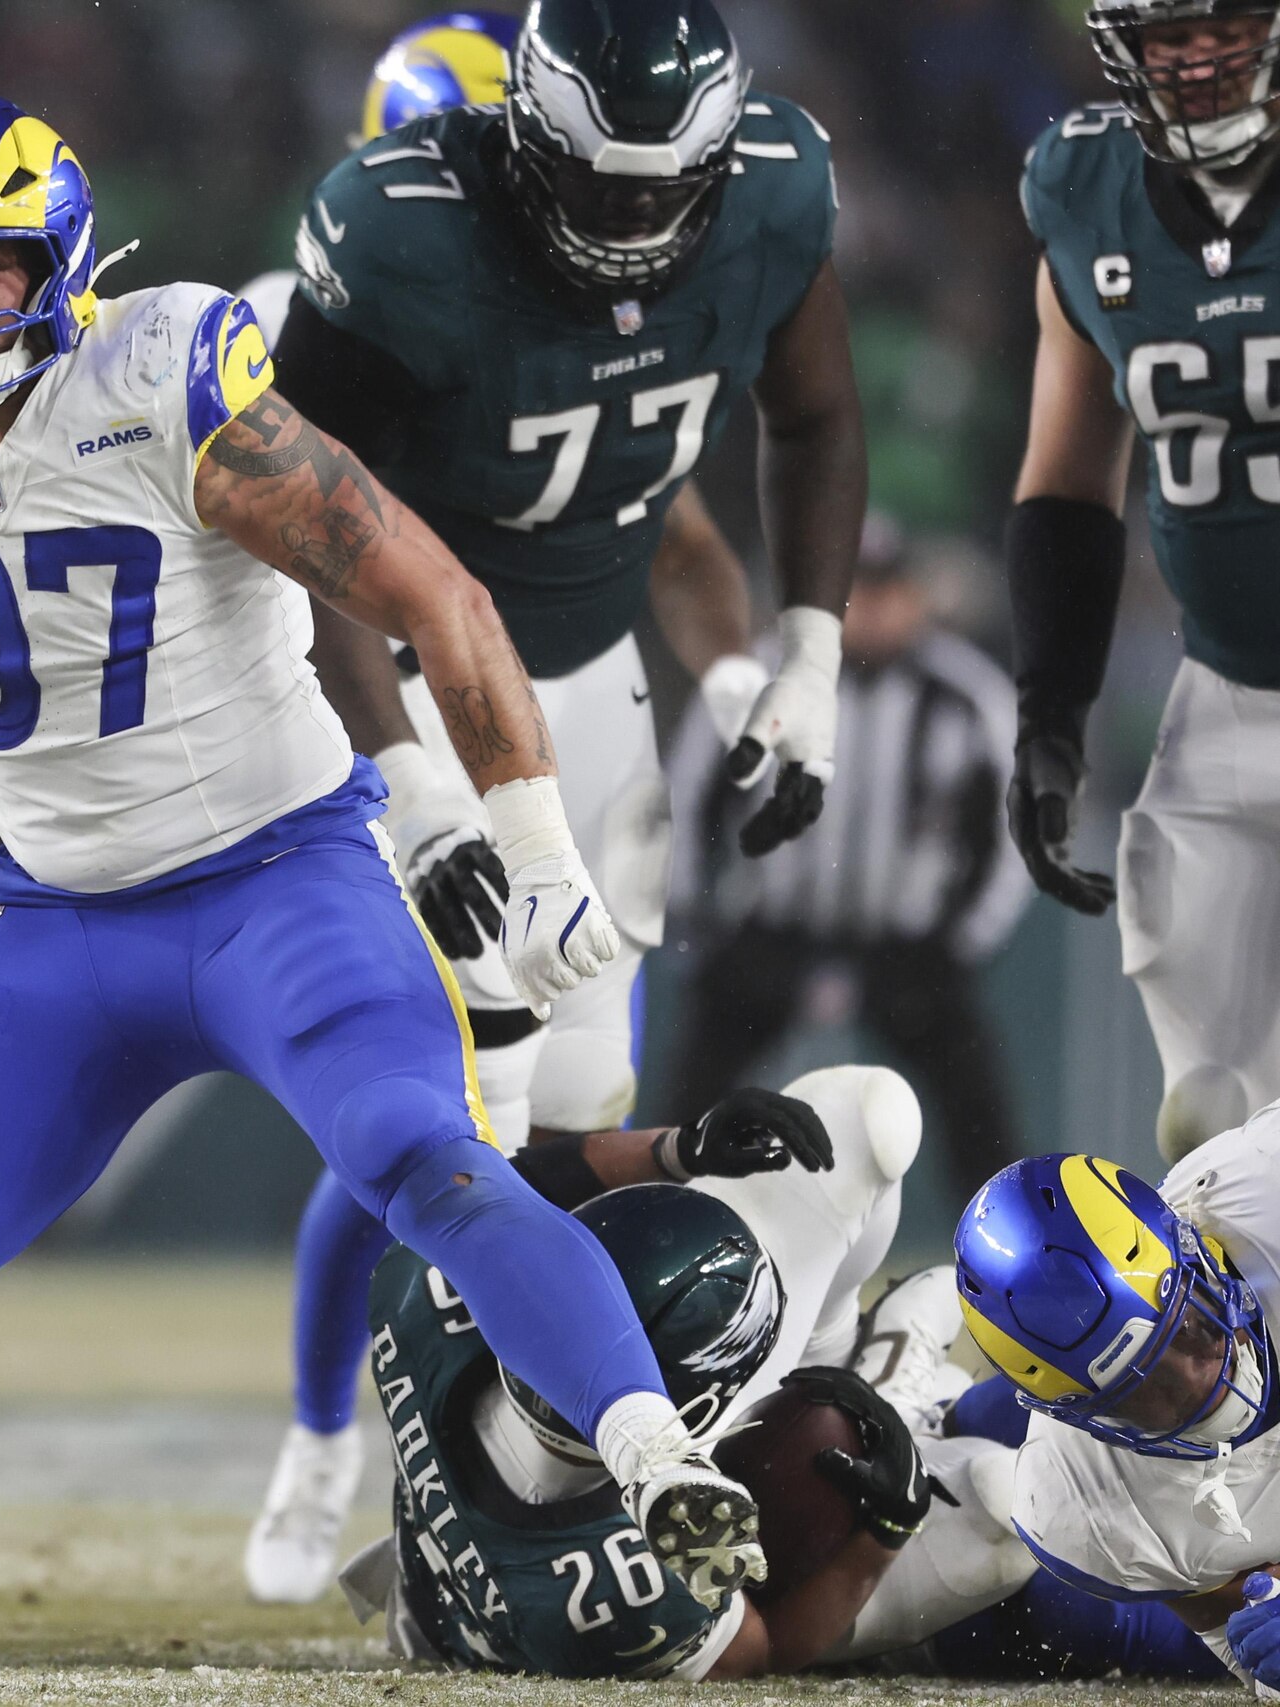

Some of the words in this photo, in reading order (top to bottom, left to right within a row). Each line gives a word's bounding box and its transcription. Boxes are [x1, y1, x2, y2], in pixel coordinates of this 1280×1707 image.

[1093, 254, 1132, 297] C
[1195, 294, 1265, 322] EAGLES
[592, 348, 665, 381] EAGLES
[75, 426, 153, 457] RAMS
[493, 372, 720, 532] 77
[372, 1323, 508, 1621] BARKLEY
[551, 1527, 666, 1634] 26
